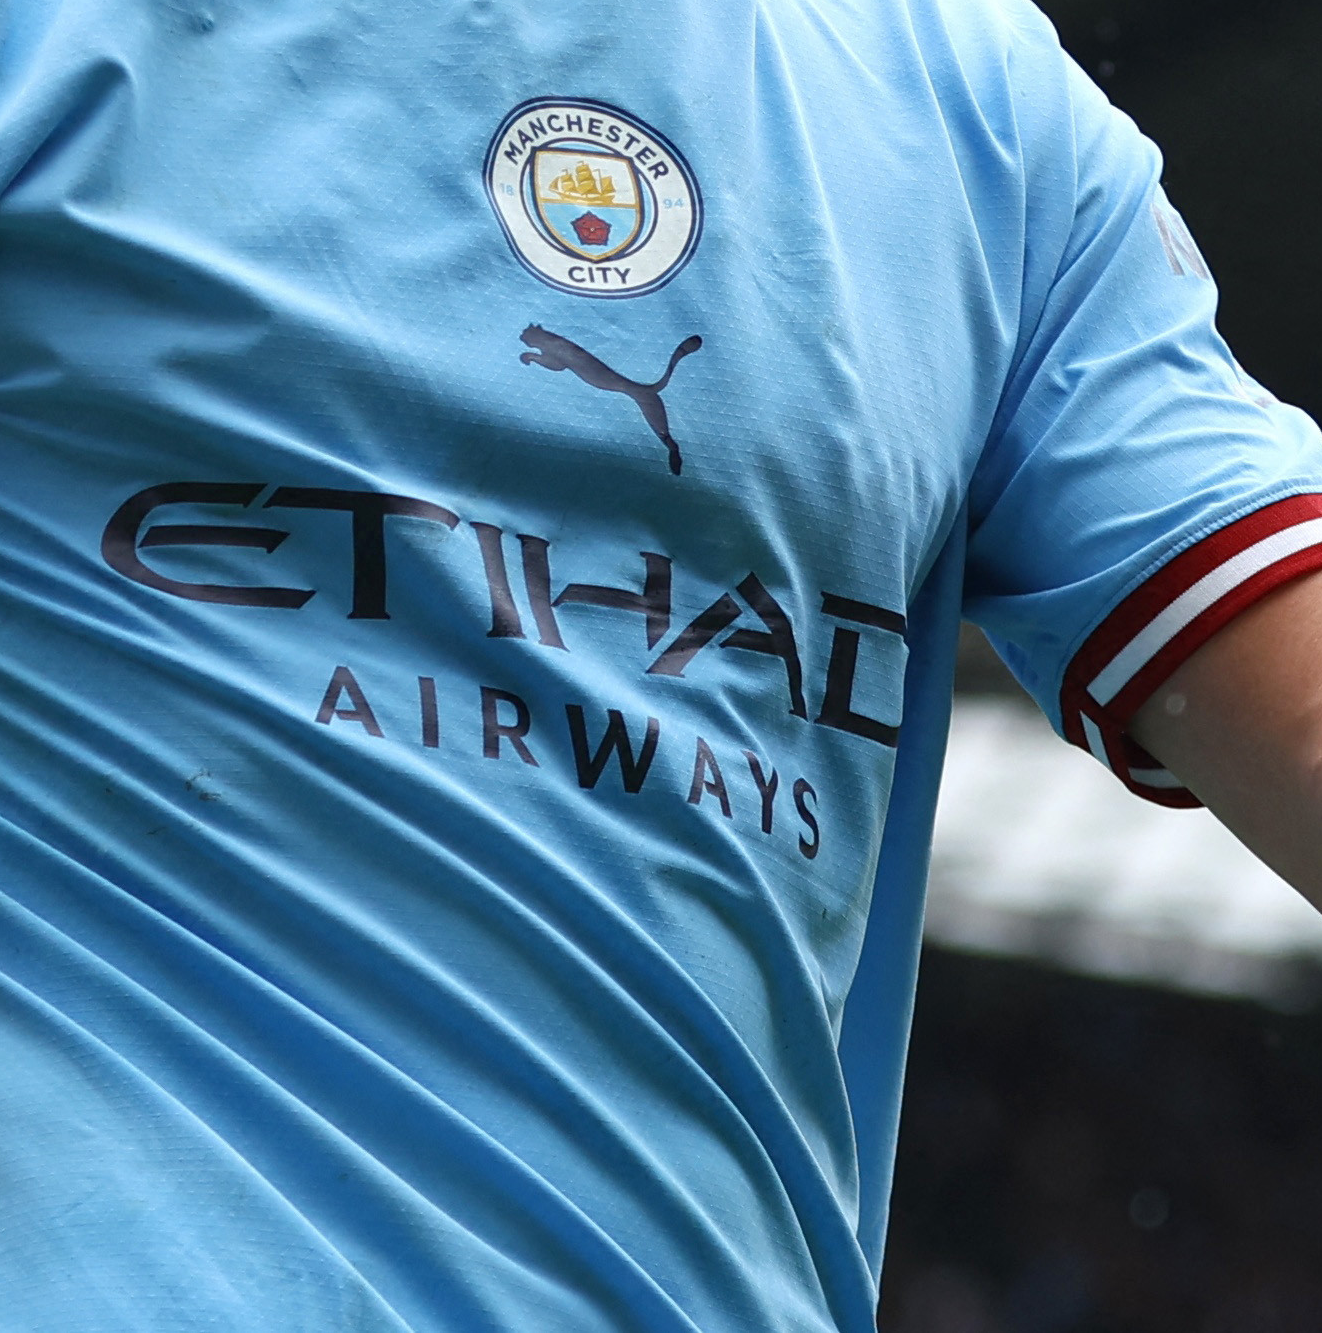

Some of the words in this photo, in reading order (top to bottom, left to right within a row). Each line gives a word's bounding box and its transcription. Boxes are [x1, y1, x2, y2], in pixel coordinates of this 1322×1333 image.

[504, 113, 669, 181] MANCHESTER
[498, 182, 515, 197] 18
[662, 197, 685, 210] 94
[567, 266, 631, 284] CITY
[100, 481, 907, 749] ETIHAD
[314, 665, 820, 860] AIRWAYS
